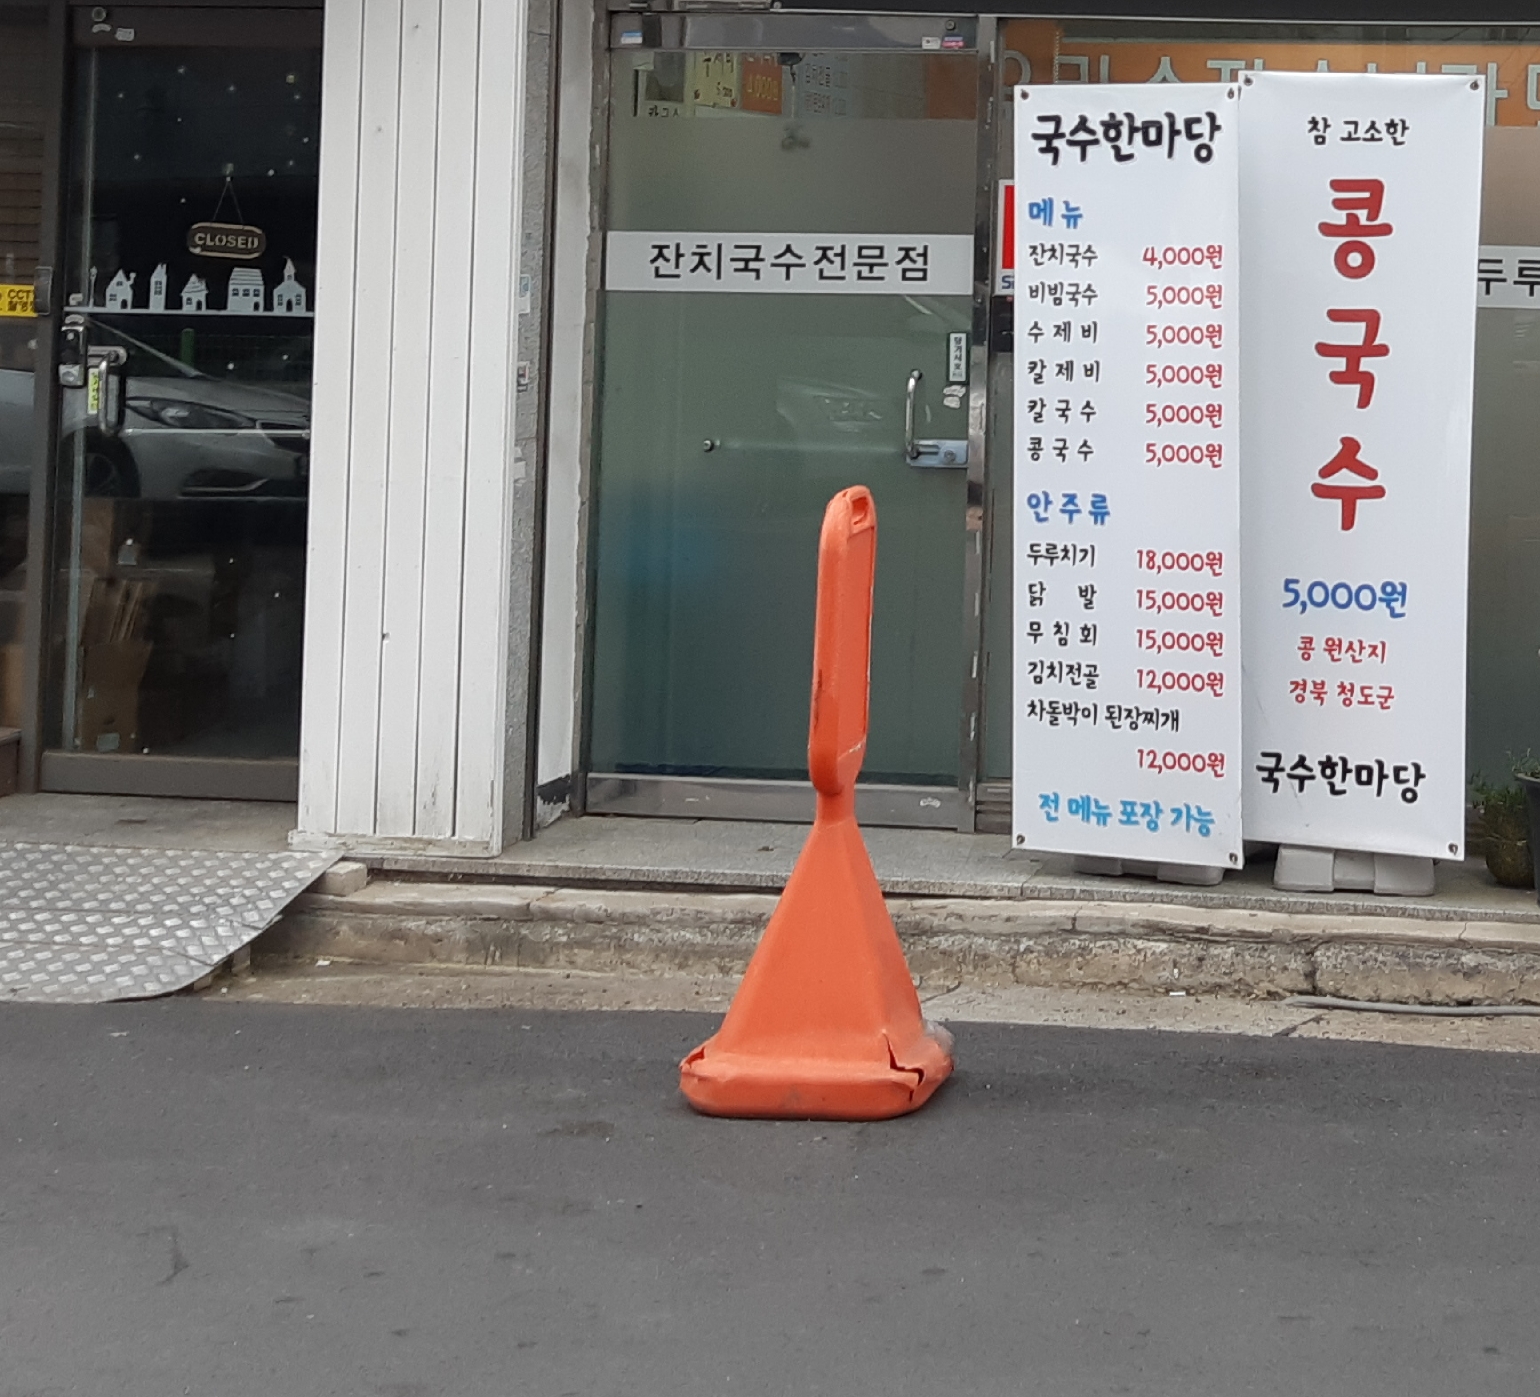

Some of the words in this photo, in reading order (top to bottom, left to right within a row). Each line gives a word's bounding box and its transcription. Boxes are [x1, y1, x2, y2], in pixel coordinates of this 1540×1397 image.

[1032, 112, 1221, 165] 국수한마당
[1308, 117, 1331, 145] 참
[1341, 119, 1409, 145] 고소한
[194, 232, 259, 249] CLOSED
[650, 243, 928, 281] 잔치국수전문점
[1029, 243, 1097, 268] 잔치국수
[1143, 245, 1222, 269] 4,000원
[1029, 282, 1097, 307] 비빔국수
[1147, 285, 1222, 309] 5,000원
[1147, 324, 1222, 349] 5,000원
[1146, 364, 1222, 388] 5,000원
[1146, 404, 1222, 428] 5,000원
[1146, 443, 1222, 468] 5,000원
[1027, 543, 1094, 566] 두루치기
[1137, 550, 1222, 576] 18,000원
[1137, 590, 1222, 617] 15,000원
[1283, 578, 1407, 618] 5,000원
[1137, 629, 1223, 657] 15,000원
[1298, 637, 1315, 661] 콩
[1323, 637, 1386, 663] 원산지
[1029, 660, 1099, 689] 김치전골
[1137, 669, 1223, 697] 12,000원
[1290, 679, 1327, 706] 경북
[1337, 681, 1394, 709] 청도군
[1028, 699, 1097, 726] 차돌박이
[1105, 705, 1179, 732] 된장찌개
[1138, 749, 1224, 777] 12,000원
[1256, 752, 1425, 803] 국수한마당
[1039, 792, 1059, 822] 전
[1068, 795, 1112, 826] 메뉴
[1118, 801, 1163, 832] 포장
[1170, 803, 1215, 837] 가능
